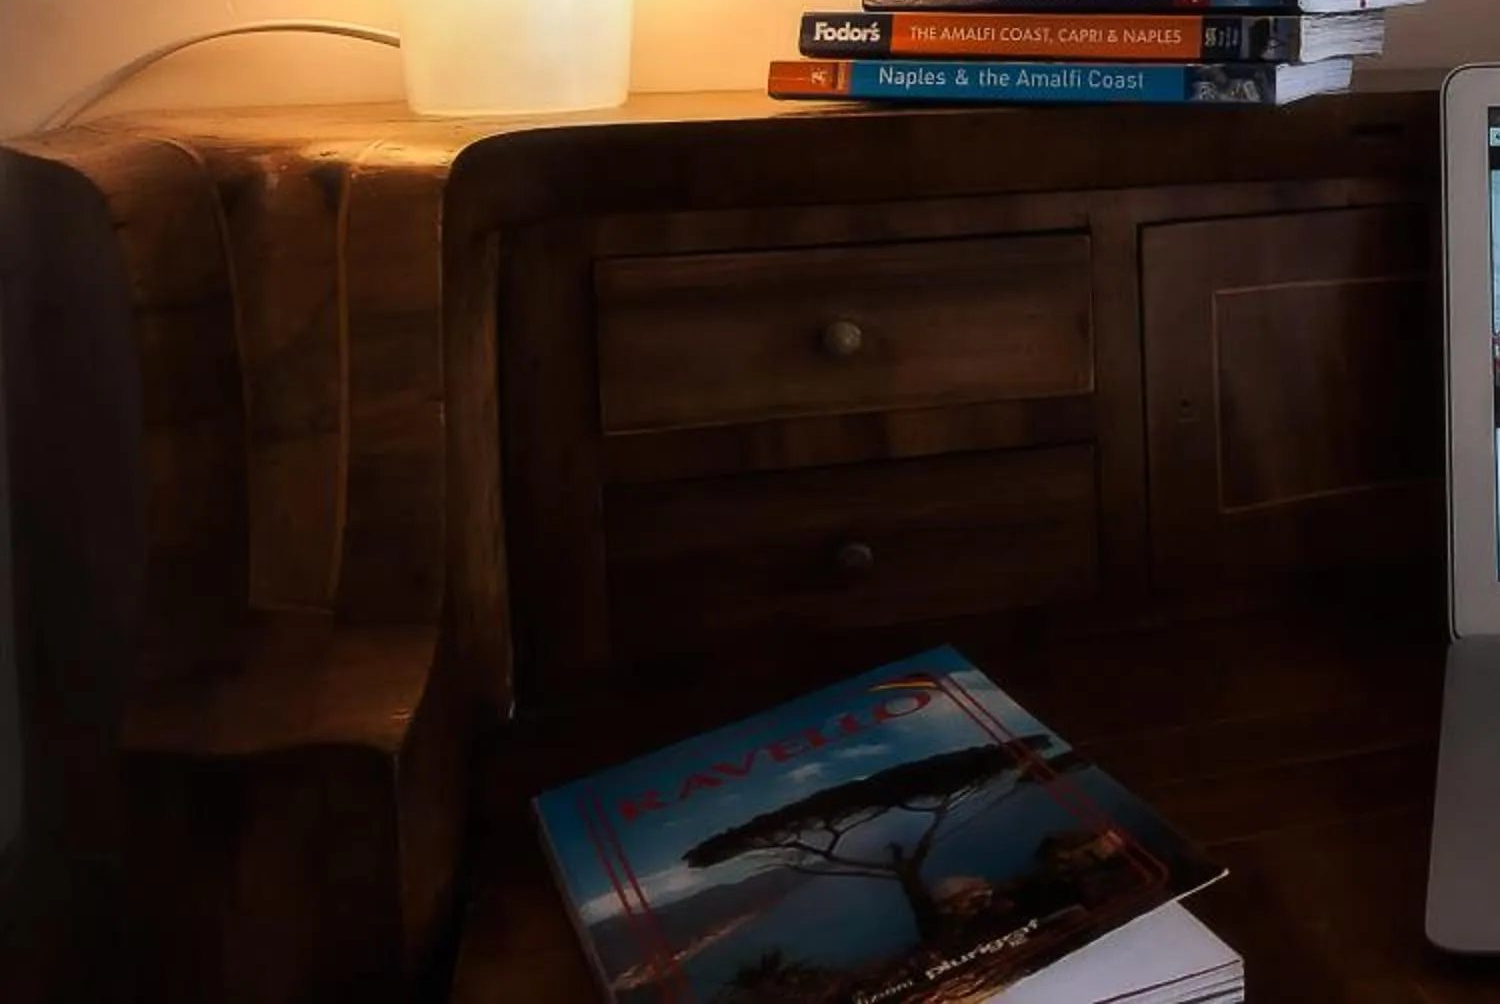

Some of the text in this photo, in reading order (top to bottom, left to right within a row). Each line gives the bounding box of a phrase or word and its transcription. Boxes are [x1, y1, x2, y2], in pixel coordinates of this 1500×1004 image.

[813, 21, 881, 42] Fodor's
[910, 26, 1183, 44] THE AMALFI COAST, CAPRI & NAPLES
[879, 66, 1144, 90] Naples & the Amalfi Coast
[616, 690, 933, 823] RAVELLO
